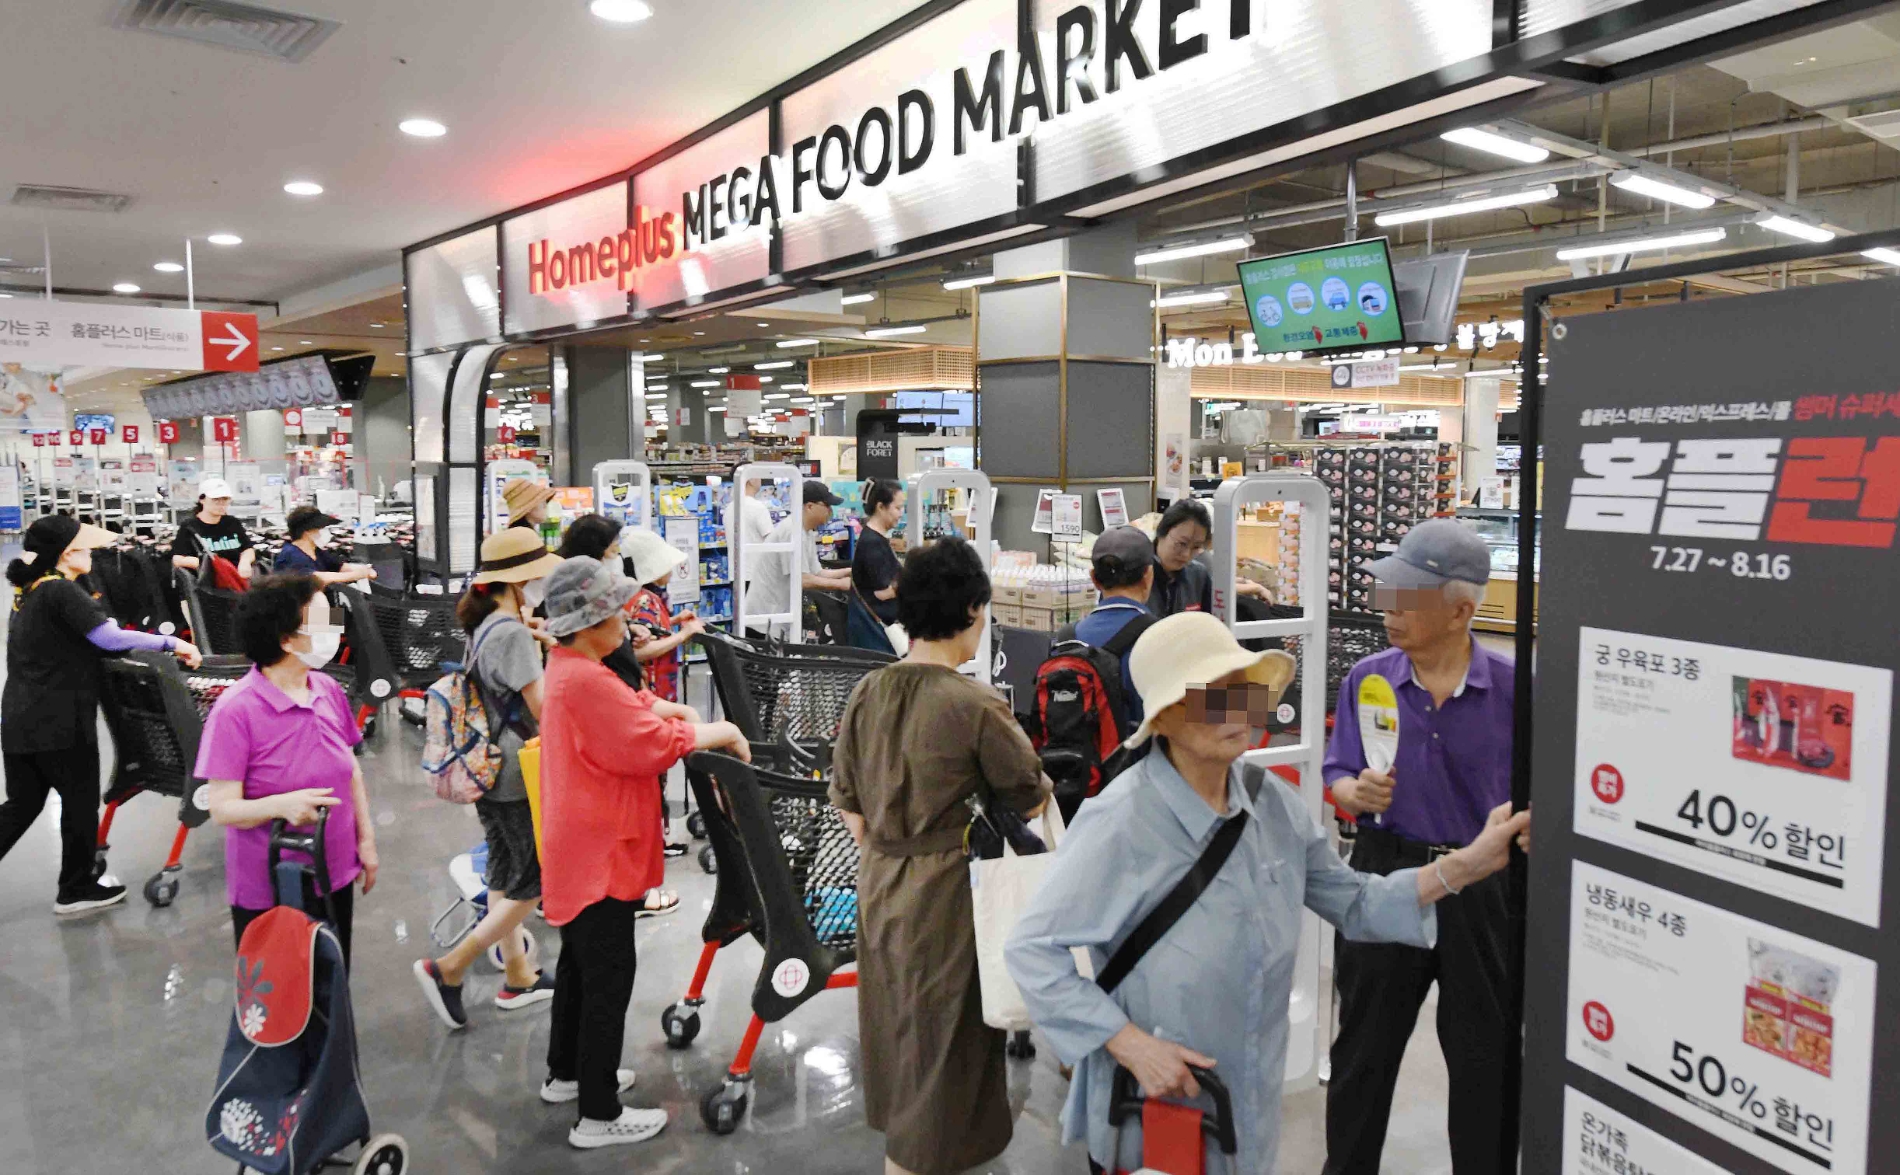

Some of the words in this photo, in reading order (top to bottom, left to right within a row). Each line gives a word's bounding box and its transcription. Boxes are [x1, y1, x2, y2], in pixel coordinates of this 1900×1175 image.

[528, 204, 680, 294] Homeplus
[682, 155, 781, 249] MEGA
[792, 88, 935, 213] FOOD
[35, 320, 51, 337] 곳
[71, 322, 131, 339] 홈플러스
[1168, 337, 1234, 368] Mon
[72, 433, 81, 443] 9
[94, 430, 101, 441] 7
[126, 428, 135, 439] 5
[165, 426, 175, 439] 3
[219, 422, 229, 437] 1
[866, 440, 893, 448] BLACK
[1564, 437, 1900, 549] 홈플런
[1651, 546, 1703, 573] 7.27
[1731, 552, 1791, 581] 8.16
[1616, 648, 1666, 673] 우육포
[1671, 657, 1700, 681] 3종
[1677, 789, 1778, 850] 40%
[1785, 822, 1844, 869] 할인
[1586, 882, 1653, 923] 냉동새우
[1657, 911, 1687, 937] 4종
[1670, 1039, 1767, 1119] 50%
[1774, 1097, 1832, 1151] 할인
[1581, 1111, 1628, 1154] 온가족
